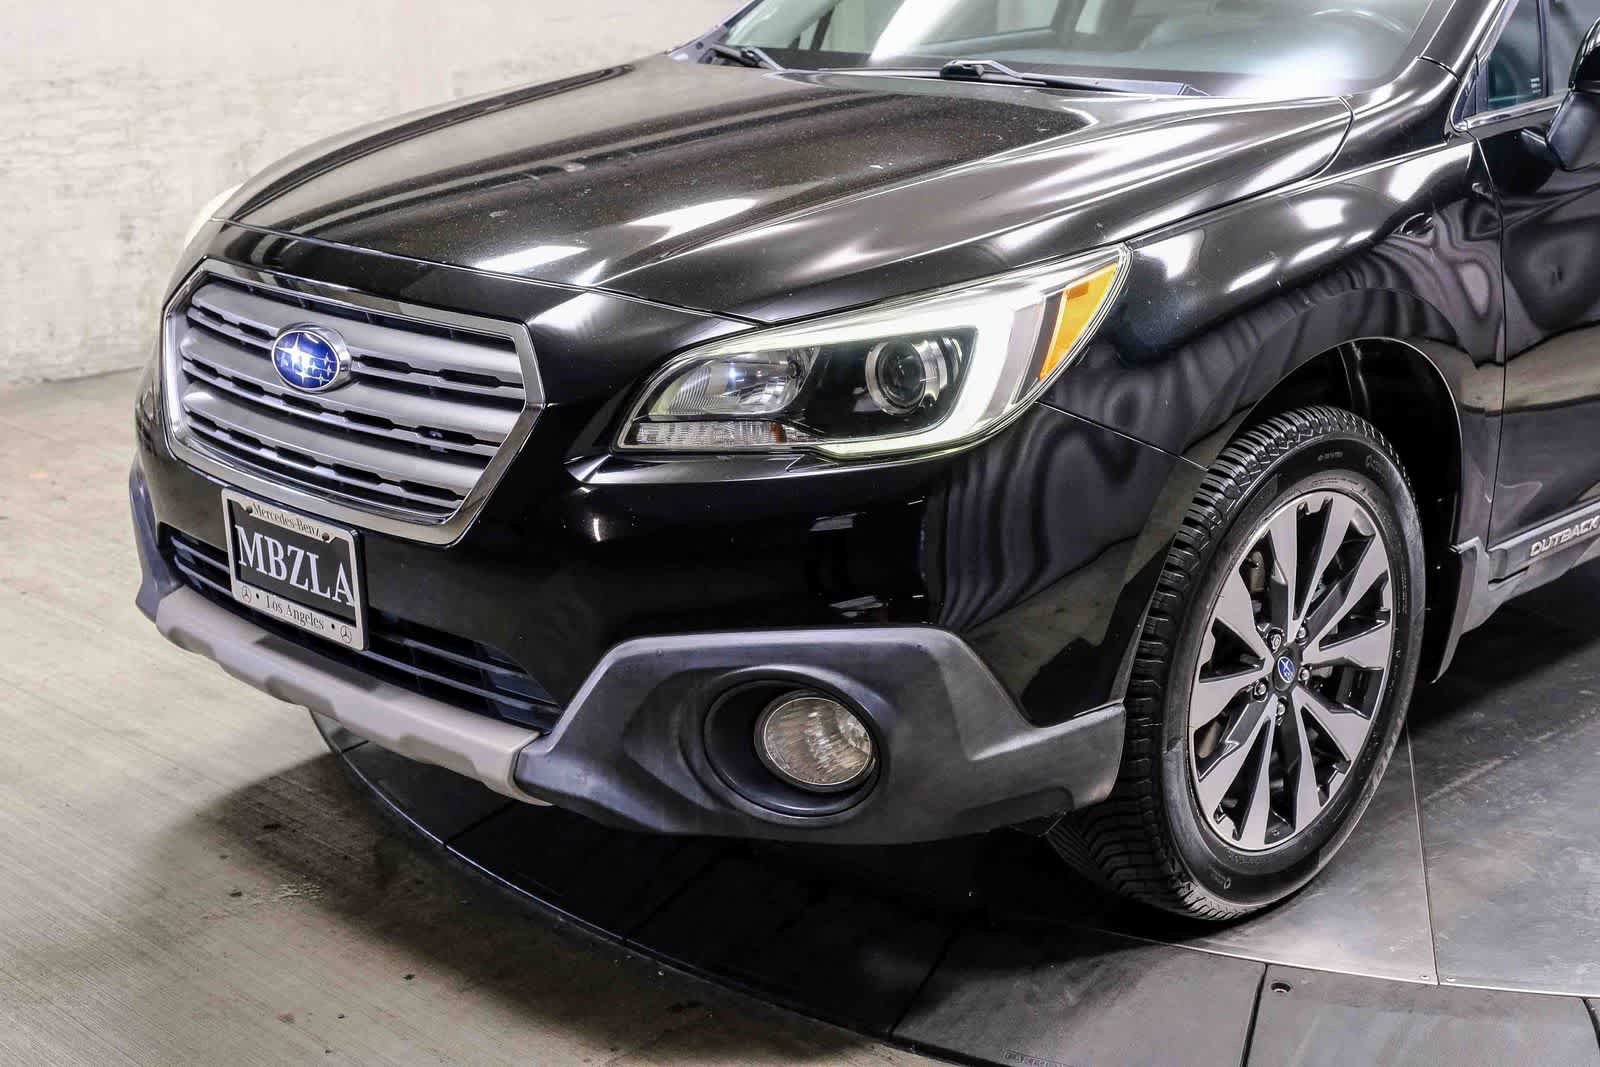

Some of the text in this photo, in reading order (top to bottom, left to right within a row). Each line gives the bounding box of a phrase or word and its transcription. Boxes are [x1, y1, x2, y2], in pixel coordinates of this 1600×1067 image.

[252, 502, 320, 537] Mercedes-Benz
[1529, 515, 1600, 557] OUTBACK
[234, 524, 355, 608] MBZLA
[265, 595, 324, 630] Los Angeles
